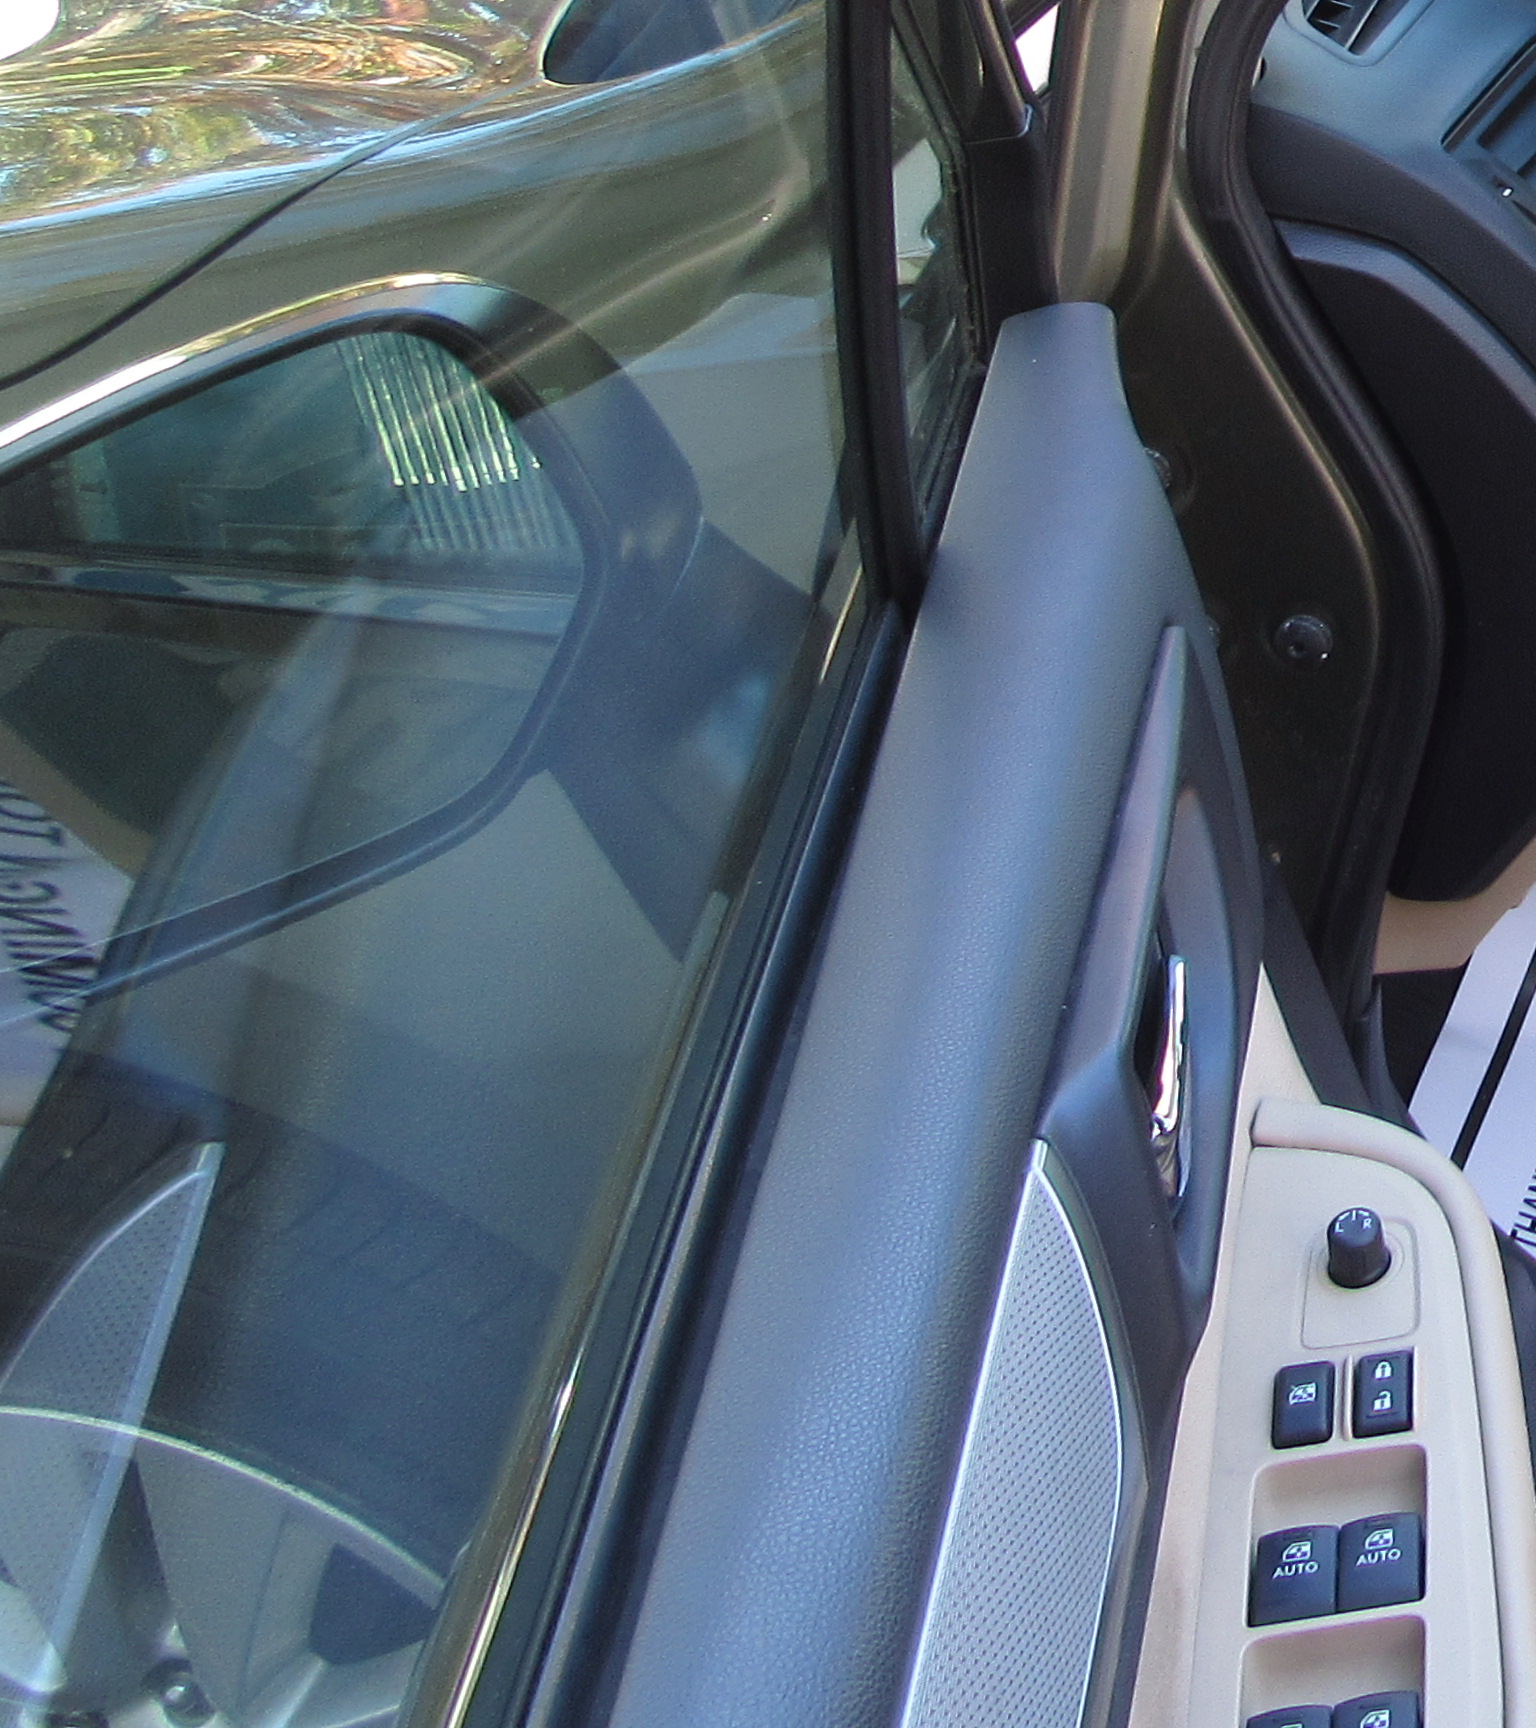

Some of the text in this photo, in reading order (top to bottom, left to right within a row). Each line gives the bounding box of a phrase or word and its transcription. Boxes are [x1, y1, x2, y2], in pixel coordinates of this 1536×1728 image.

[1334, 1218, 1372, 1233] L R
[1356, 1548, 1401, 1566] AUTO
[1272, 1561, 1319, 1579] AUTO
